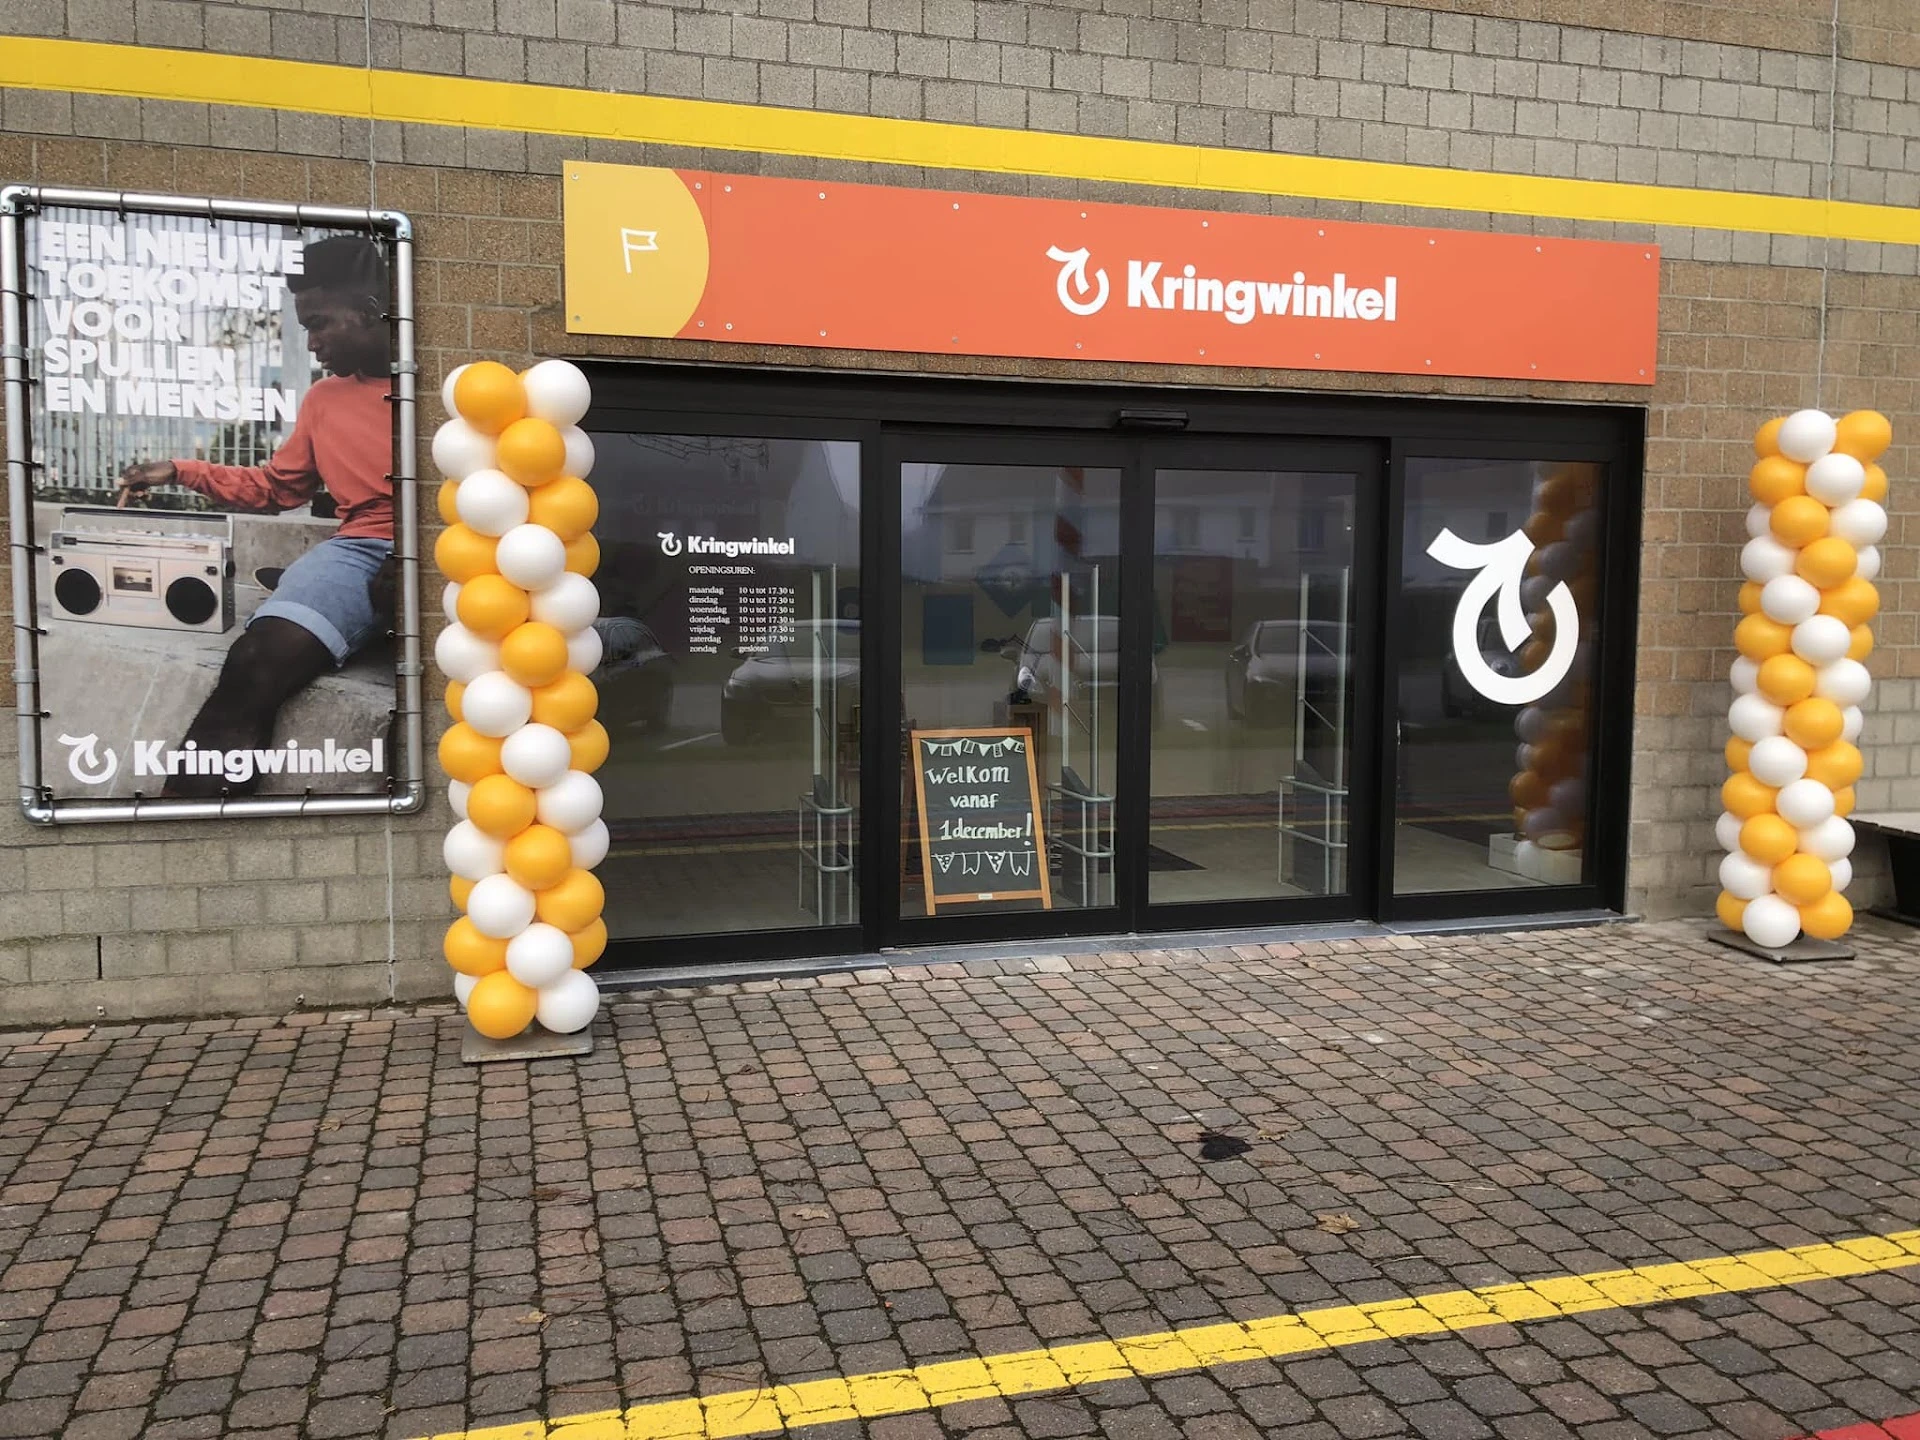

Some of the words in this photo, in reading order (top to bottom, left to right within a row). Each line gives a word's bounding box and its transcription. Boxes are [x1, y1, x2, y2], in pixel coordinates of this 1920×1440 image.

[41, 221, 125, 261] EEN
[136, 228, 304, 275] NIEUWE
[42, 260, 287, 311] TOEKOMST
[1127, 259, 1397, 324] Kringwinkel
[43, 300, 182, 342] VOOR
[43, 338, 235, 382] SPULLEN
[44, 377, 105, 414] EN
[116, 380, 296, 422] MENSEN
[687, 535, 795, 557] Kringwinkel
[688, 566, 756, 575] OPENINGSUREN:
[689, 586, 724, 595] maandag
[689, 596, 718, 604] dinsdag
[689, 605, 727, 614] woensdag
[690, 615, 730, 624] donderdag
[690, 625, 715, 634] vrijdag
[690, 635, 722, 644] zaterdag
[690, 645, 717, 654] zondag
[134, 738, 384, 784] Kringwinkel
[950, 793, 999, 808] vanaf
